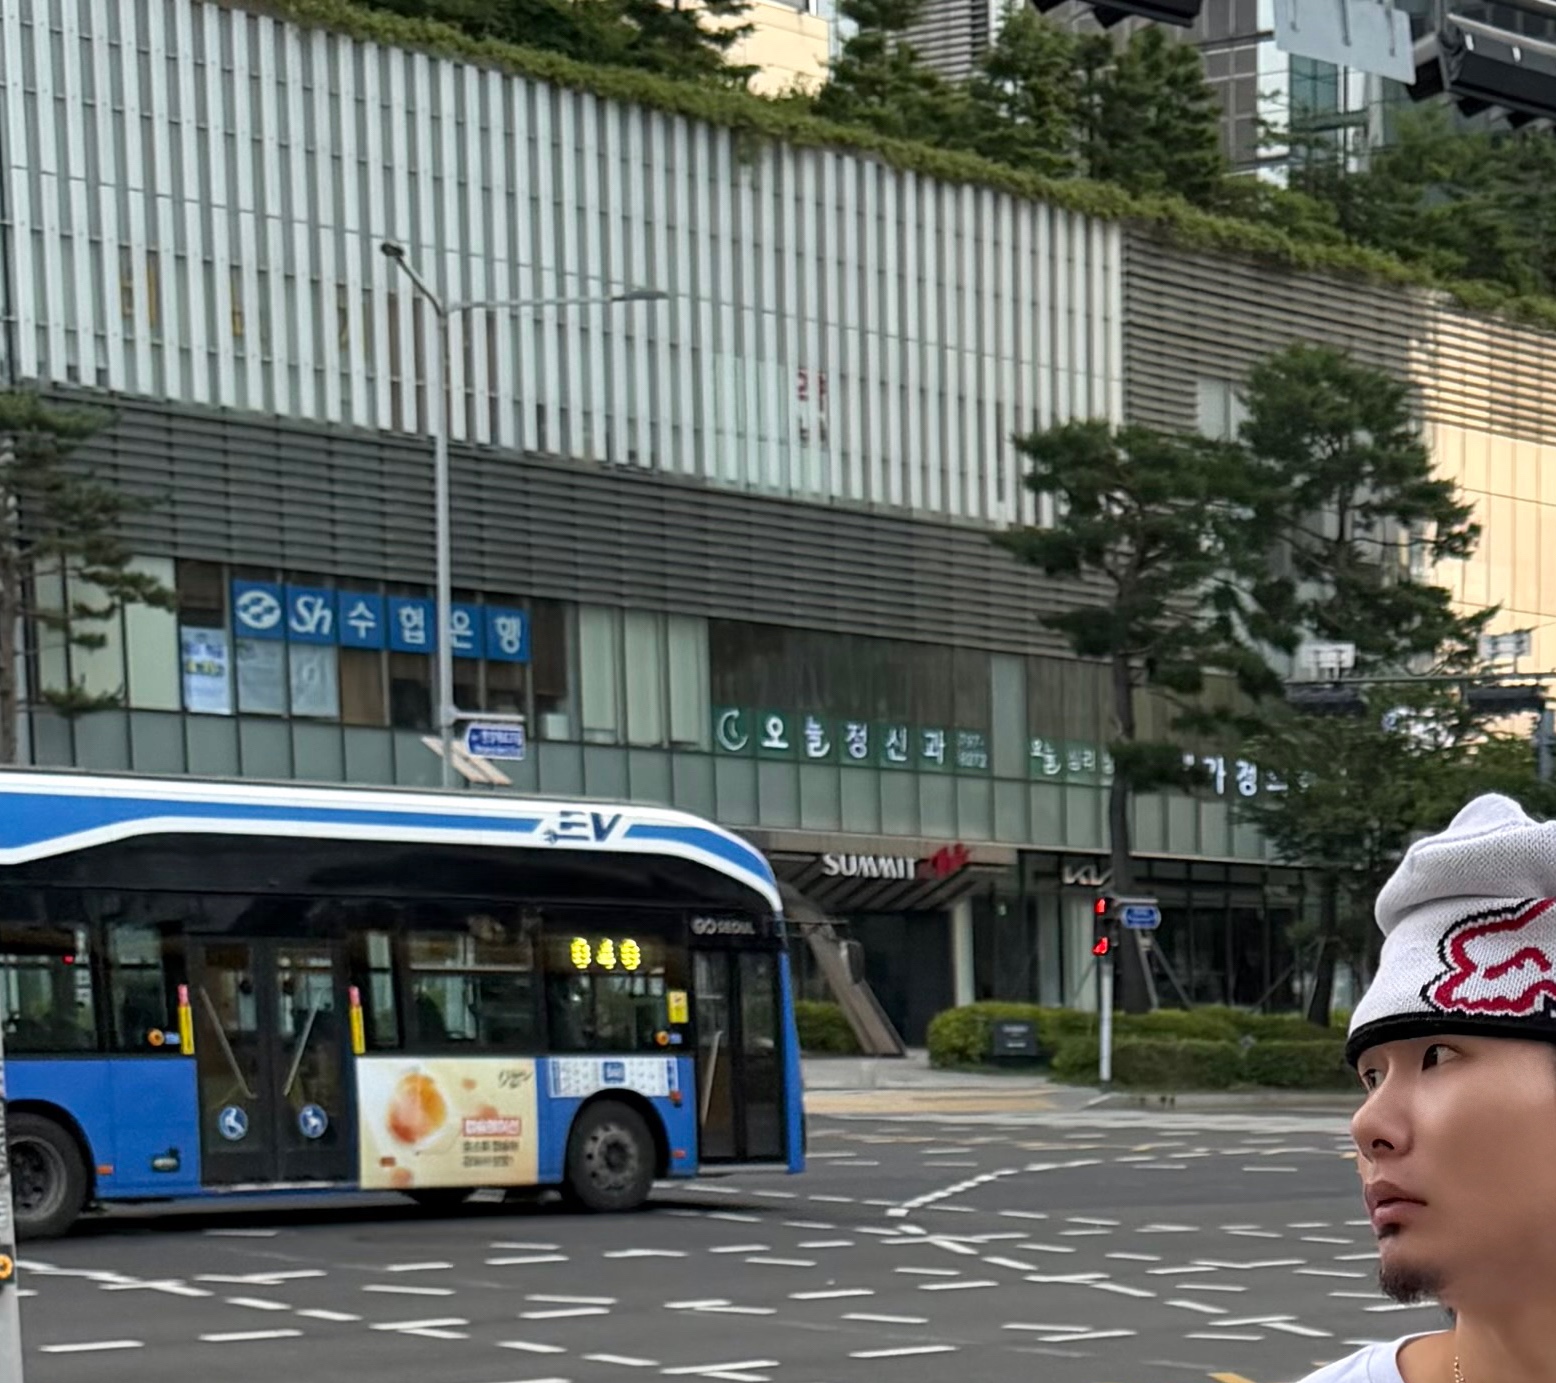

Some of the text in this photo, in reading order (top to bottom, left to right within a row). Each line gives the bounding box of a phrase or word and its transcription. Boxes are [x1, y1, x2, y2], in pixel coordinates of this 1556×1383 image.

[290, 595, 522, 654] Sh 수협은행
[546, 810, 623, 844] EV
[822, 853, 917, 880] SUMMIT
